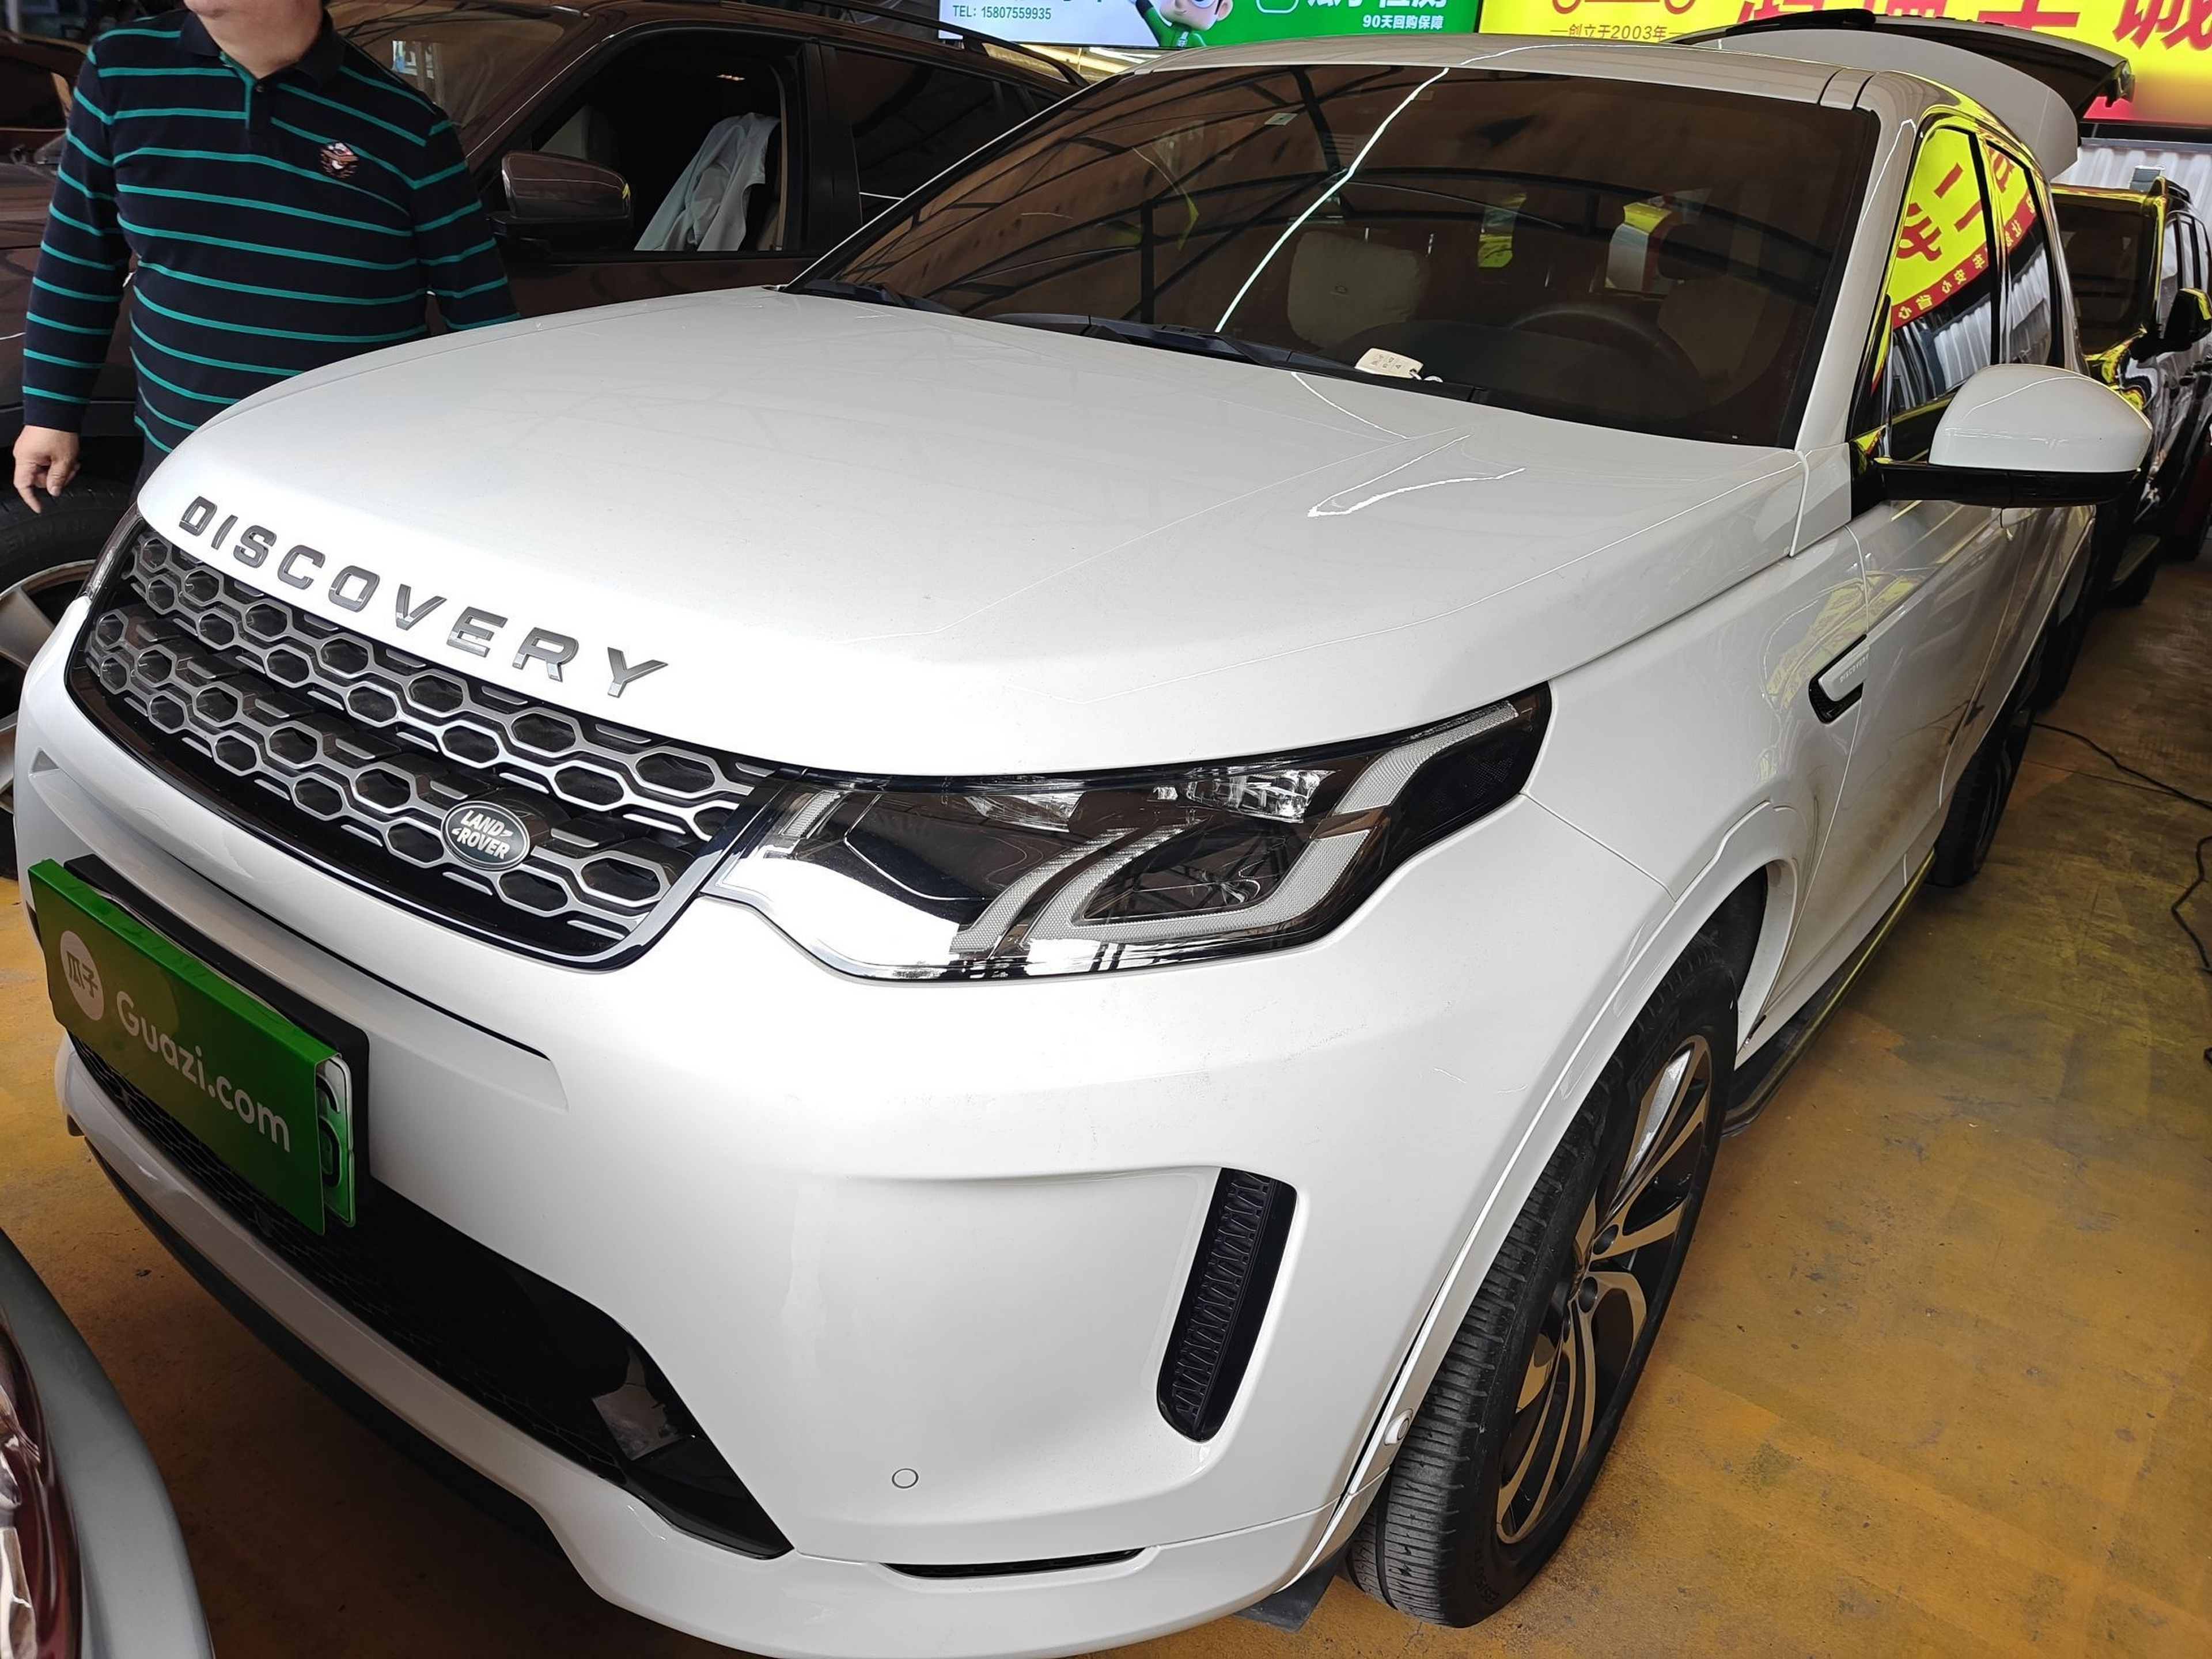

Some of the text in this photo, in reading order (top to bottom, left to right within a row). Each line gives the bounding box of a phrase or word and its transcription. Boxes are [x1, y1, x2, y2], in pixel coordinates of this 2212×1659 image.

[953, 5, 1051, 20] TEL: 15807559935
[1362, 14, 1444, 30] 90天回购保障
[1569, 24, 1667, 40] 创立于2003年
[179, 495, 669, 699] DISCOVERY
[460, 809, 505, 836] LAND
[456, 827, 510, 859] ROVER
[66, 950, 99, 999] 瓜子
[116, 990, 290, 1153] Guazi.com
